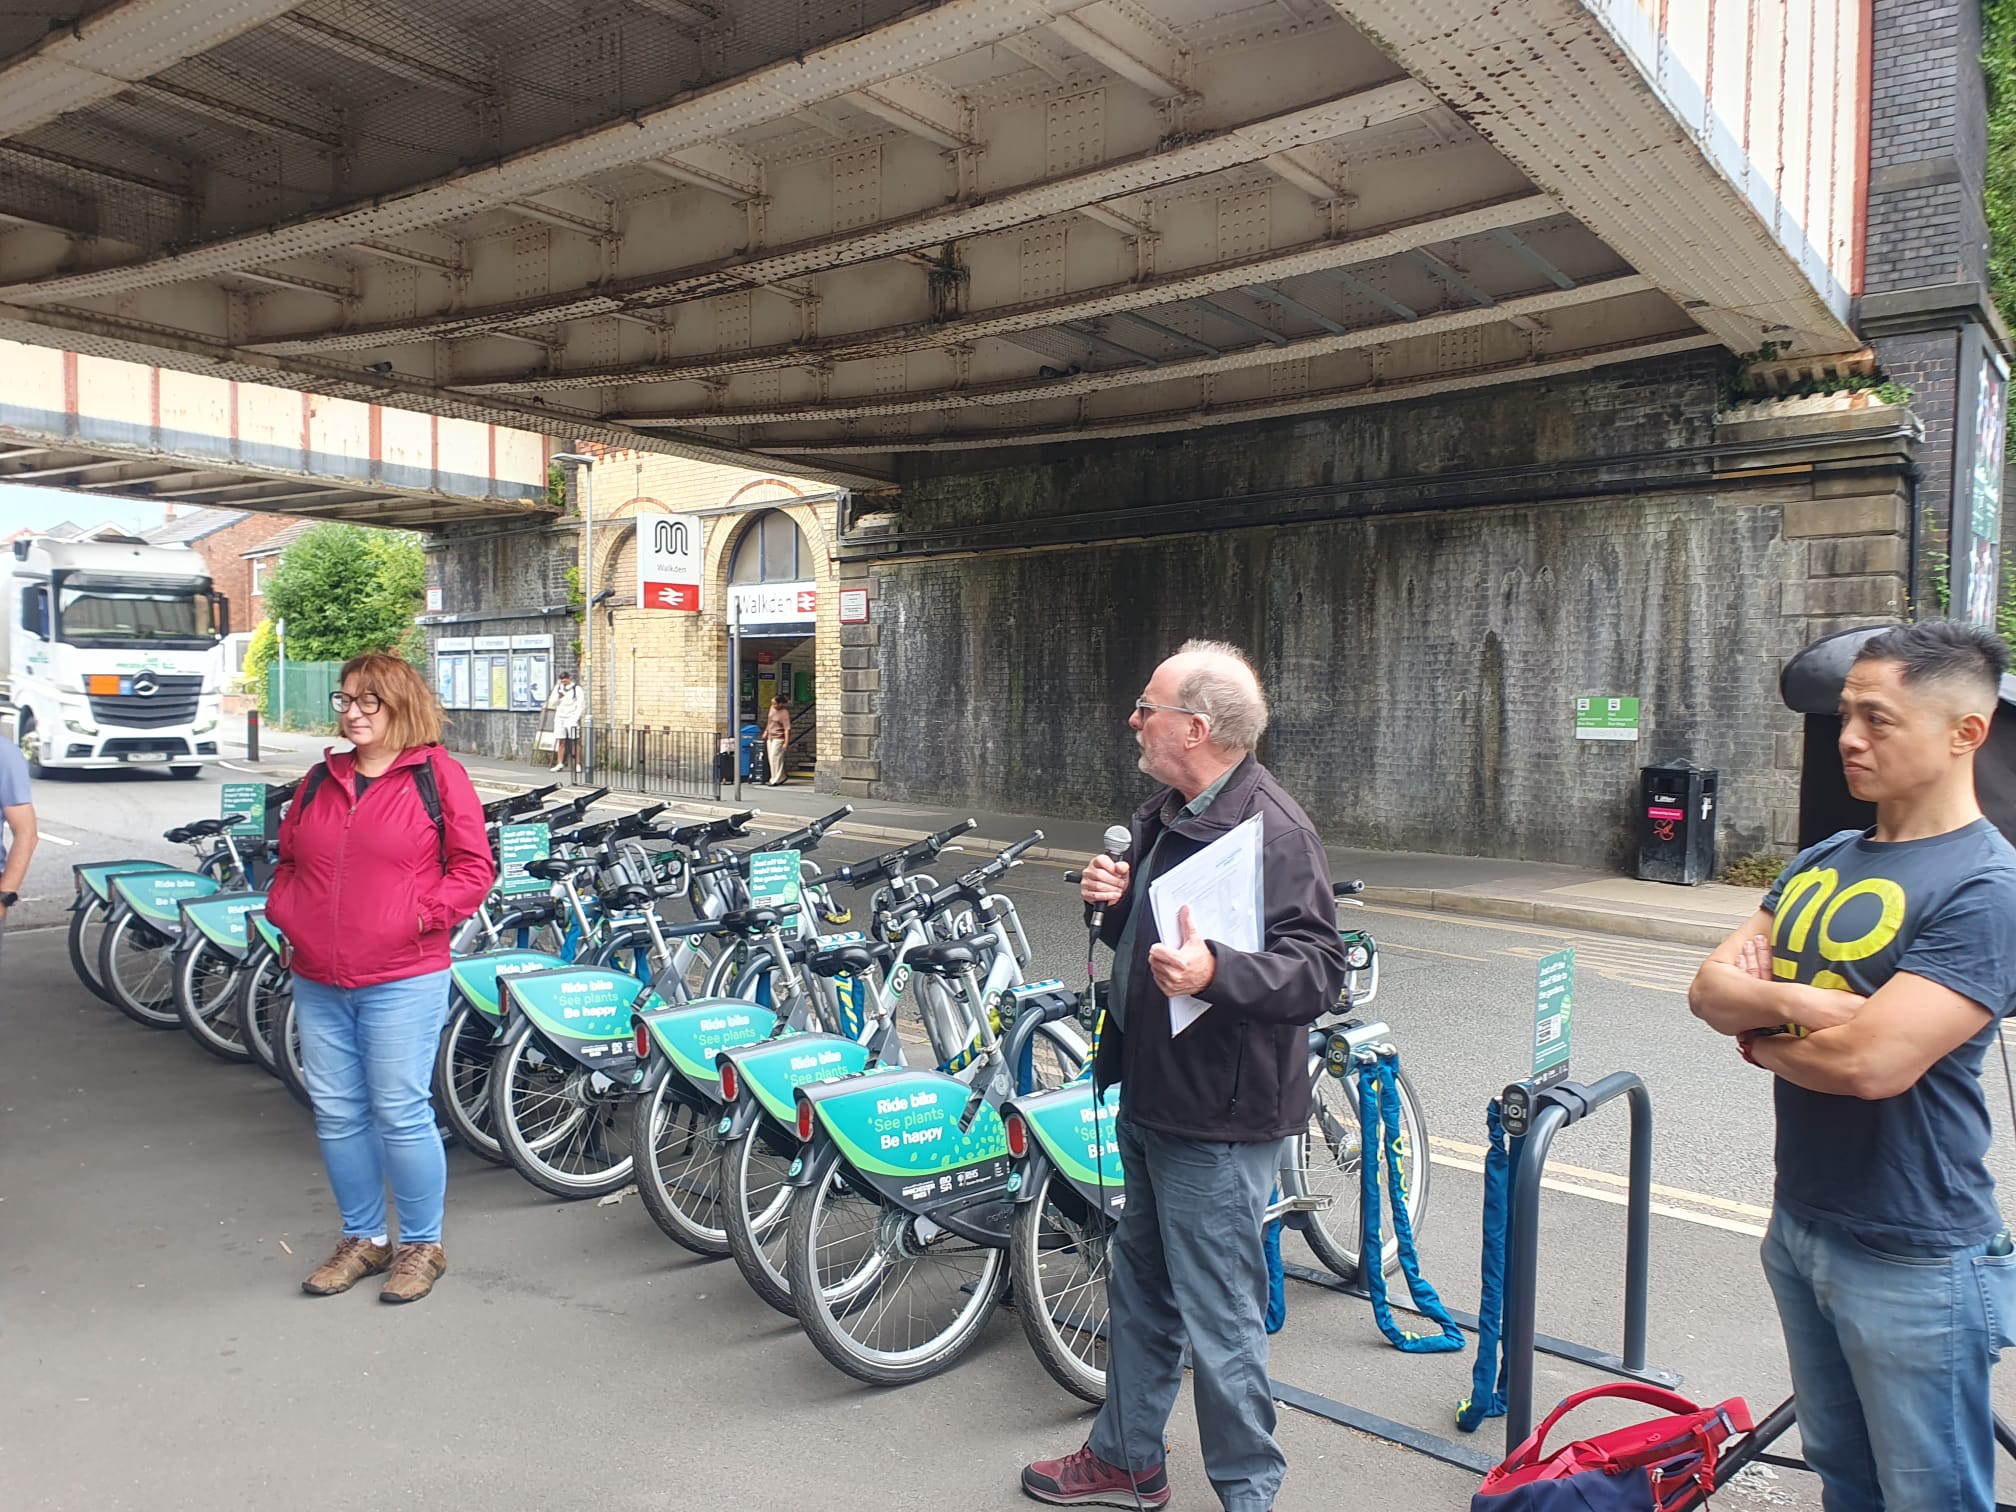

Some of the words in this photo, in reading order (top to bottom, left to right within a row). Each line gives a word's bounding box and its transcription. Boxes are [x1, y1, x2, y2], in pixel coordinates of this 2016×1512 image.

[155, 880, 175, 888] Ride
[561, 982, 588, 993] Ride
[590, 980, 613, 992] bike
[893, 968, 909, 991] 06
[559, 994, 581, 1006] See
[584, 992, 618, 1004] plants
[564, 1008, 580, 1018] Be
[582, 1005, 617, 1018] happy
[700, 1018, 727, 1032] Ride
[727, 1015, 750, 1027] bike
[698, 1031, 721, 1045] See
[723, 1028, 756, 1043] plants
[704, 1047, 720, 1060] Be
[790, 1055, 818, 1071] Ride
[817, 1051, 842, 1066] bike
[791, 1071, 813, 1086] See
[815, 1065, 848, 1082] plants
[877, 1098, 908, 1114] Ride
[910, 1092, 937, 1108] bike
[874, 1117, 900, 1133] See
[904, 1109, 945, 1128] plants
[880, 1134, 900, 1150] Be
[903, 1126, 943, 1145] happy
[1088, 1143, 1105, 1159] Be
